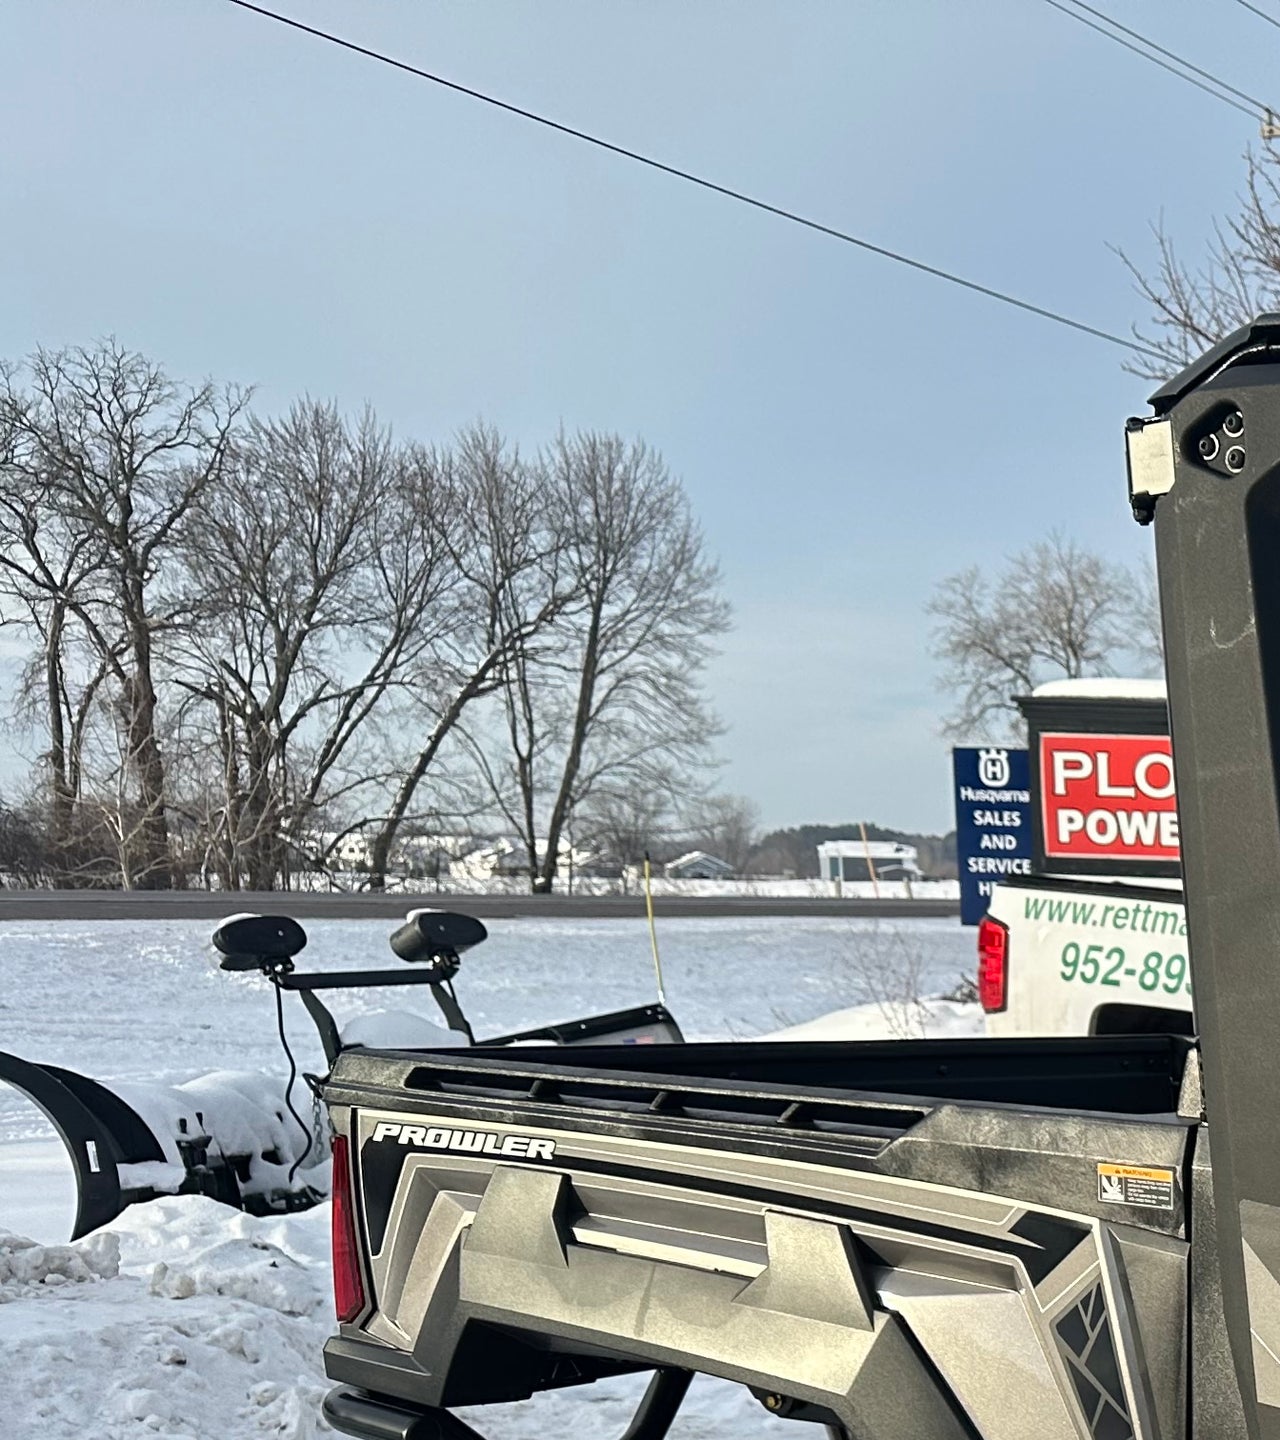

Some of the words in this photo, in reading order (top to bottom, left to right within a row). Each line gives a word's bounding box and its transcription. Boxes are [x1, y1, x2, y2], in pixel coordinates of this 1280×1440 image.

[960, 786, 1030, 804] Husqvarna
[973, 810, 1022, 827] SALES
[980, 834, 1017, 851] AND
[967, 857, 1032, 875] SERVICE
[1060, 941, 1193, 995] 952-89
[371, 1121, 557, 1161] PROWLER
